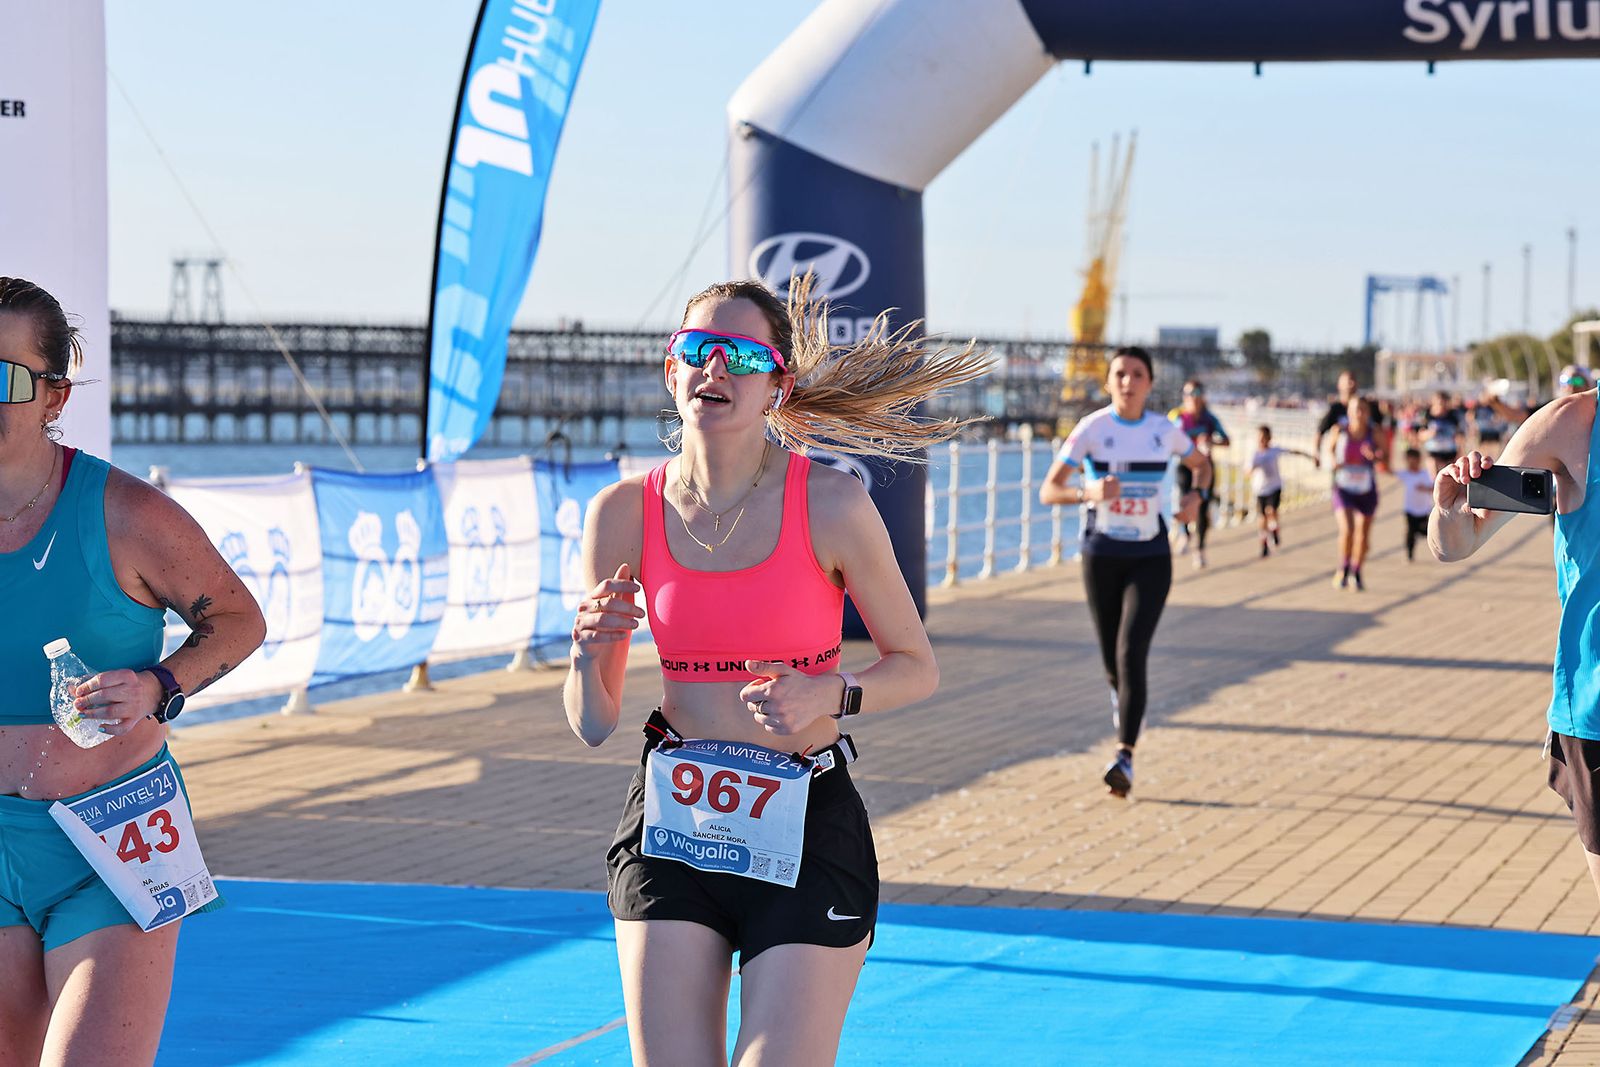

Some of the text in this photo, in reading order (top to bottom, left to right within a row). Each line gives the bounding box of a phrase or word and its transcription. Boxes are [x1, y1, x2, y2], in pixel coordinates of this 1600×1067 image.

[1402, 0, 1600, 50] Syrlu
[0, 99, 26, 118] ER
[1109, 498, 1149, 517] 423
[721, 745, 772, 762] AVATEL
[106, 786, 153, 814] AVATEL
[150, 773, 173, 797] '24
[671, 762, 781, 819] 967
[99, 809, 180, 864] 43
[692, 831, 747, 845] SANCHEZ MORA
[709, 824, 732, 833] ALICIA
[671, 832, 740, 862] Wayalia
[149, 881, 170, 894] FRIAS
[156, 894, 177, 911] ia
